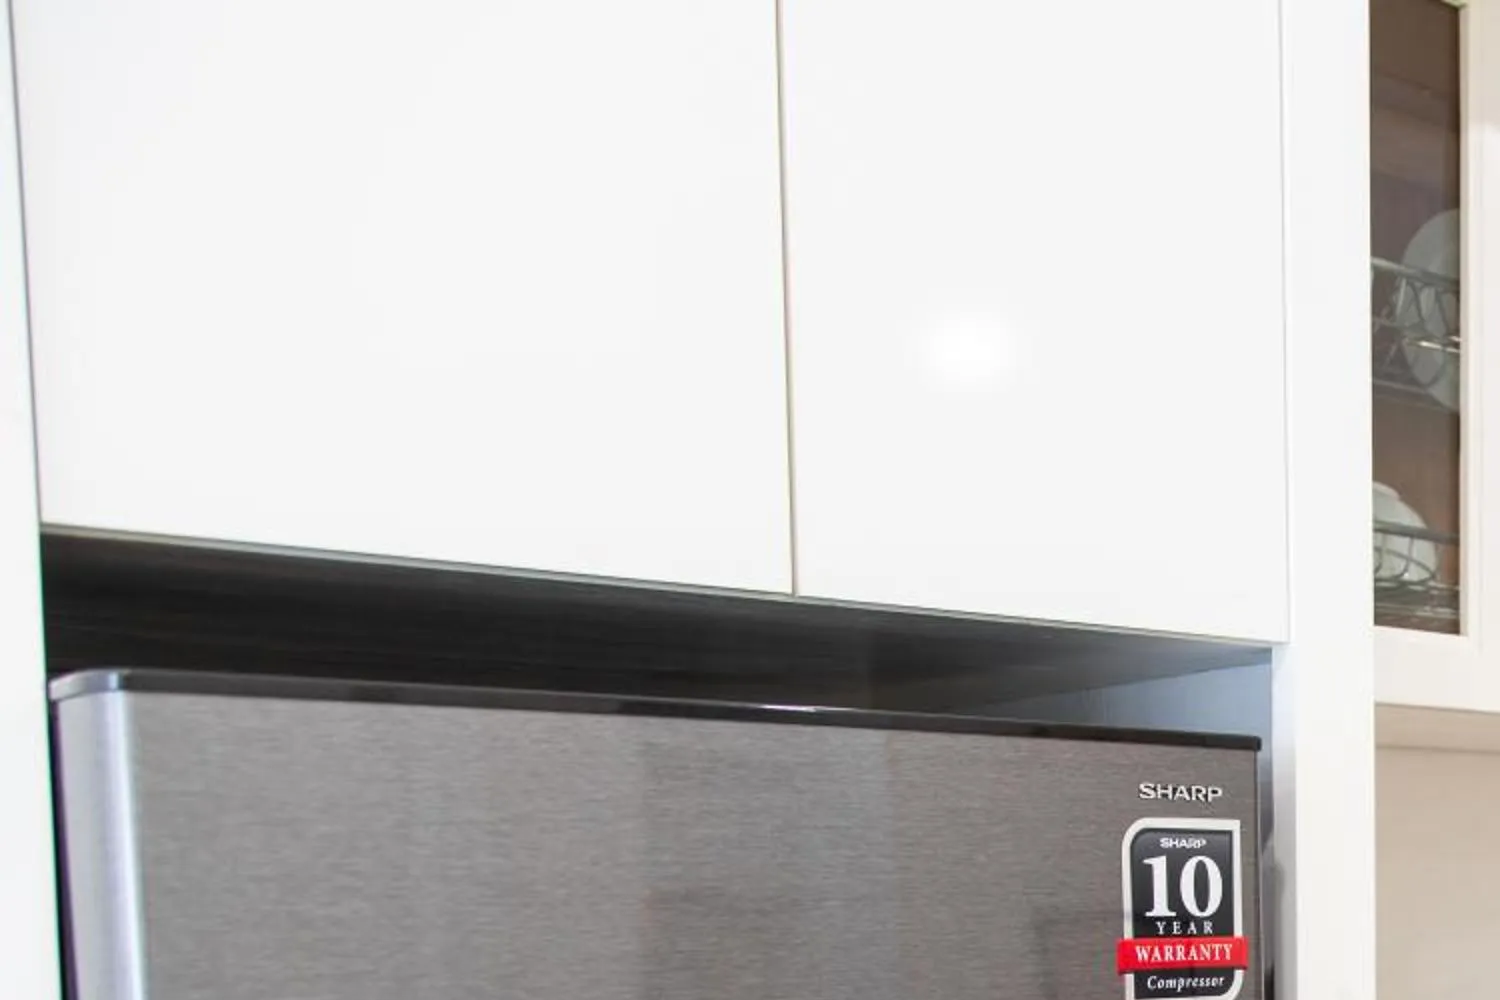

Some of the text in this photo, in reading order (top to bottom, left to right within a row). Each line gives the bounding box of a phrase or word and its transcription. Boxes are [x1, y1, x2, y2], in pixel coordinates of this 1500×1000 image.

[1138, 782, 1223, 802] SHARP
[1159, 837, 1207, 849] SHARP
[1142, 855, 1223, 918] 10
[1156, 921, 1213, 935] YEAR
[1135, 943, 1233, 962] WARRANTY
[1147, 974, 1225, 992] Compressor
